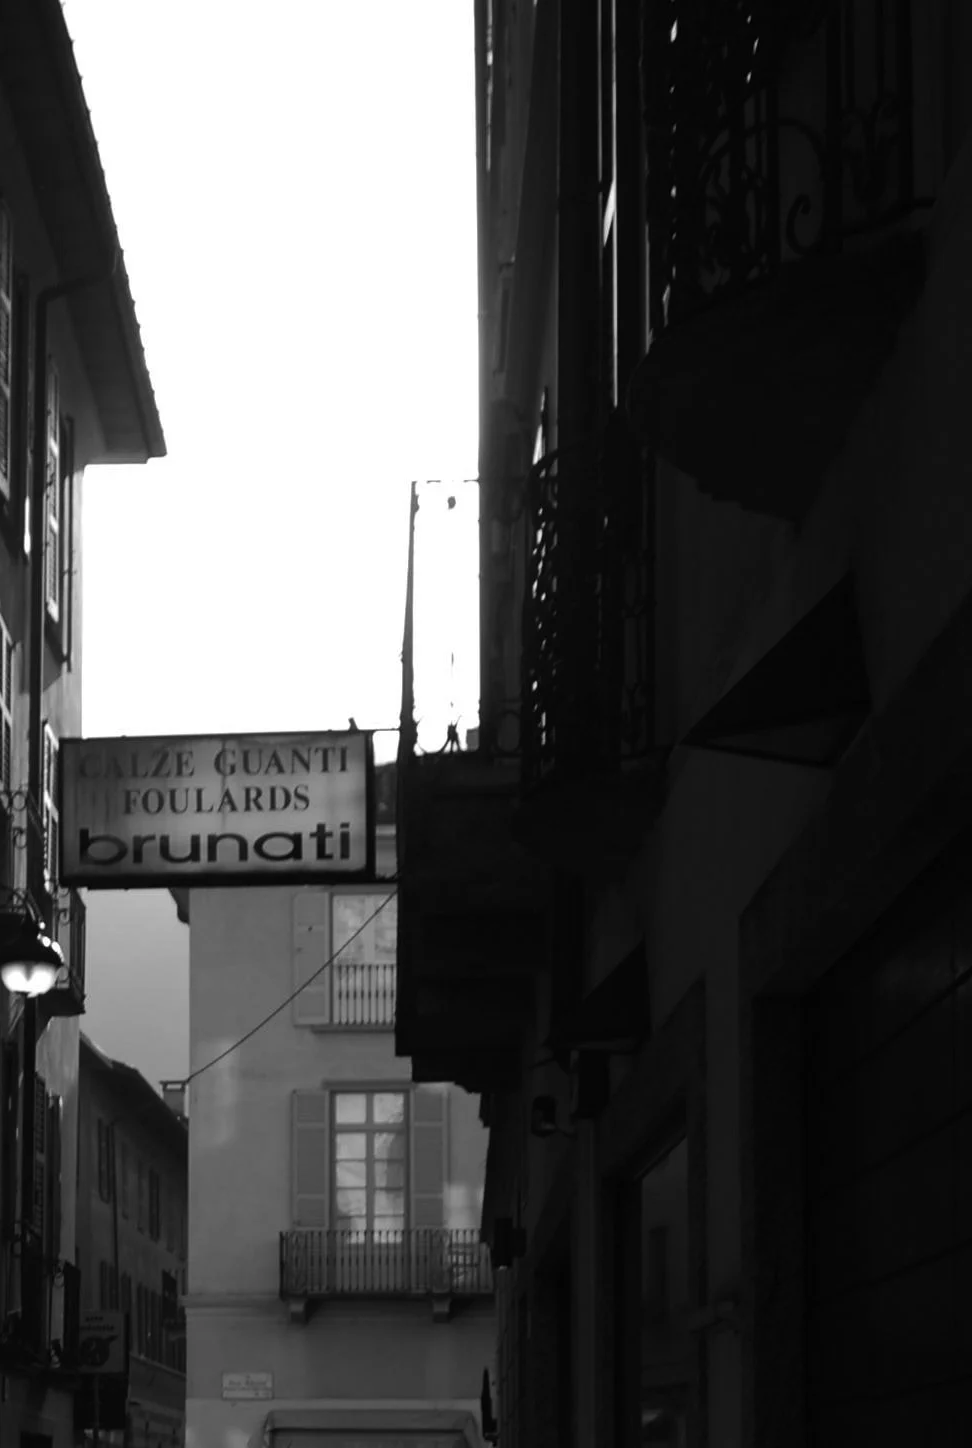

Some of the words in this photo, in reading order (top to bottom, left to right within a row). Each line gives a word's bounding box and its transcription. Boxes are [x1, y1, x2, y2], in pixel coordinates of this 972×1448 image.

[80, 748, 195, 779] CALZE
[214, 745, 349, 776] GUANTI
[123, 784, 310, 816] FOULARDS
[79, 822, 351, 866] brunati
